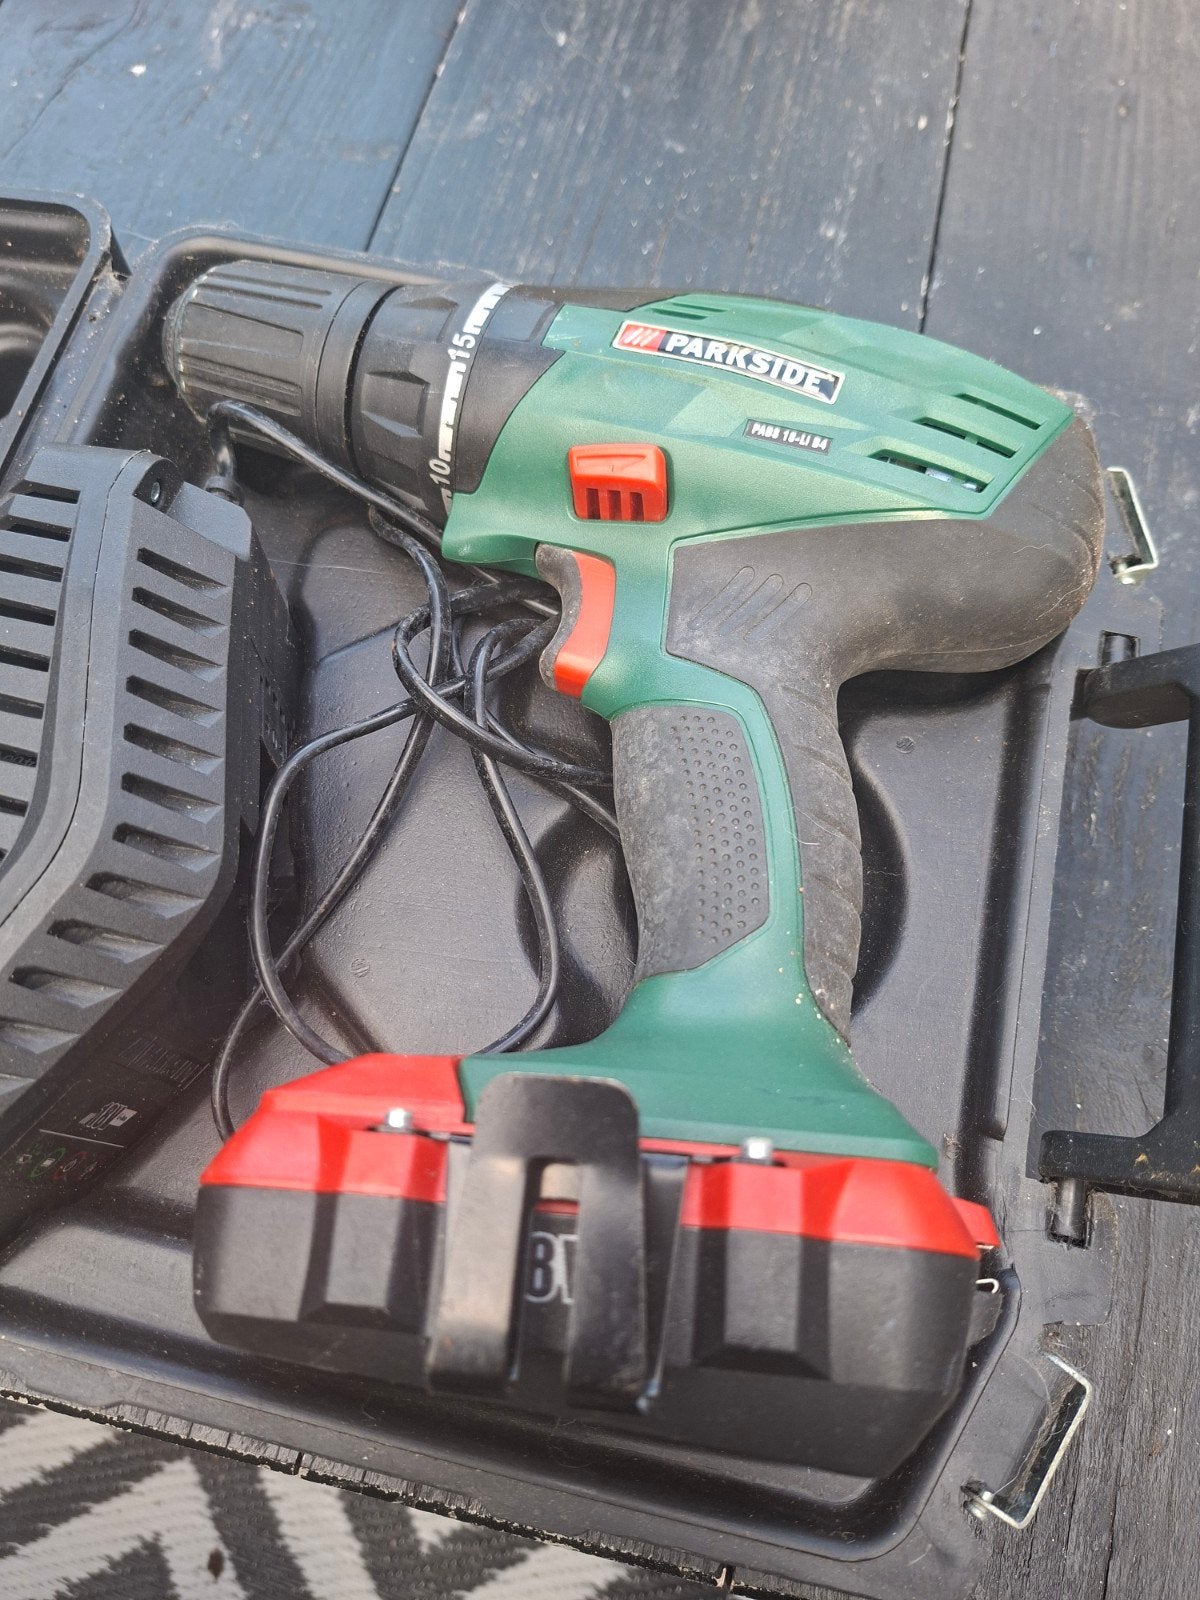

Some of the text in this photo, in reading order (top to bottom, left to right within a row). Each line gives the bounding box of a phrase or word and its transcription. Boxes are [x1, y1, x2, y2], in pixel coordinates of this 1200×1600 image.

[448, 333, 476, 359] 15
[665, 332, 826, 392] PARKSIDE
[429, 458, 451, 486] 10
